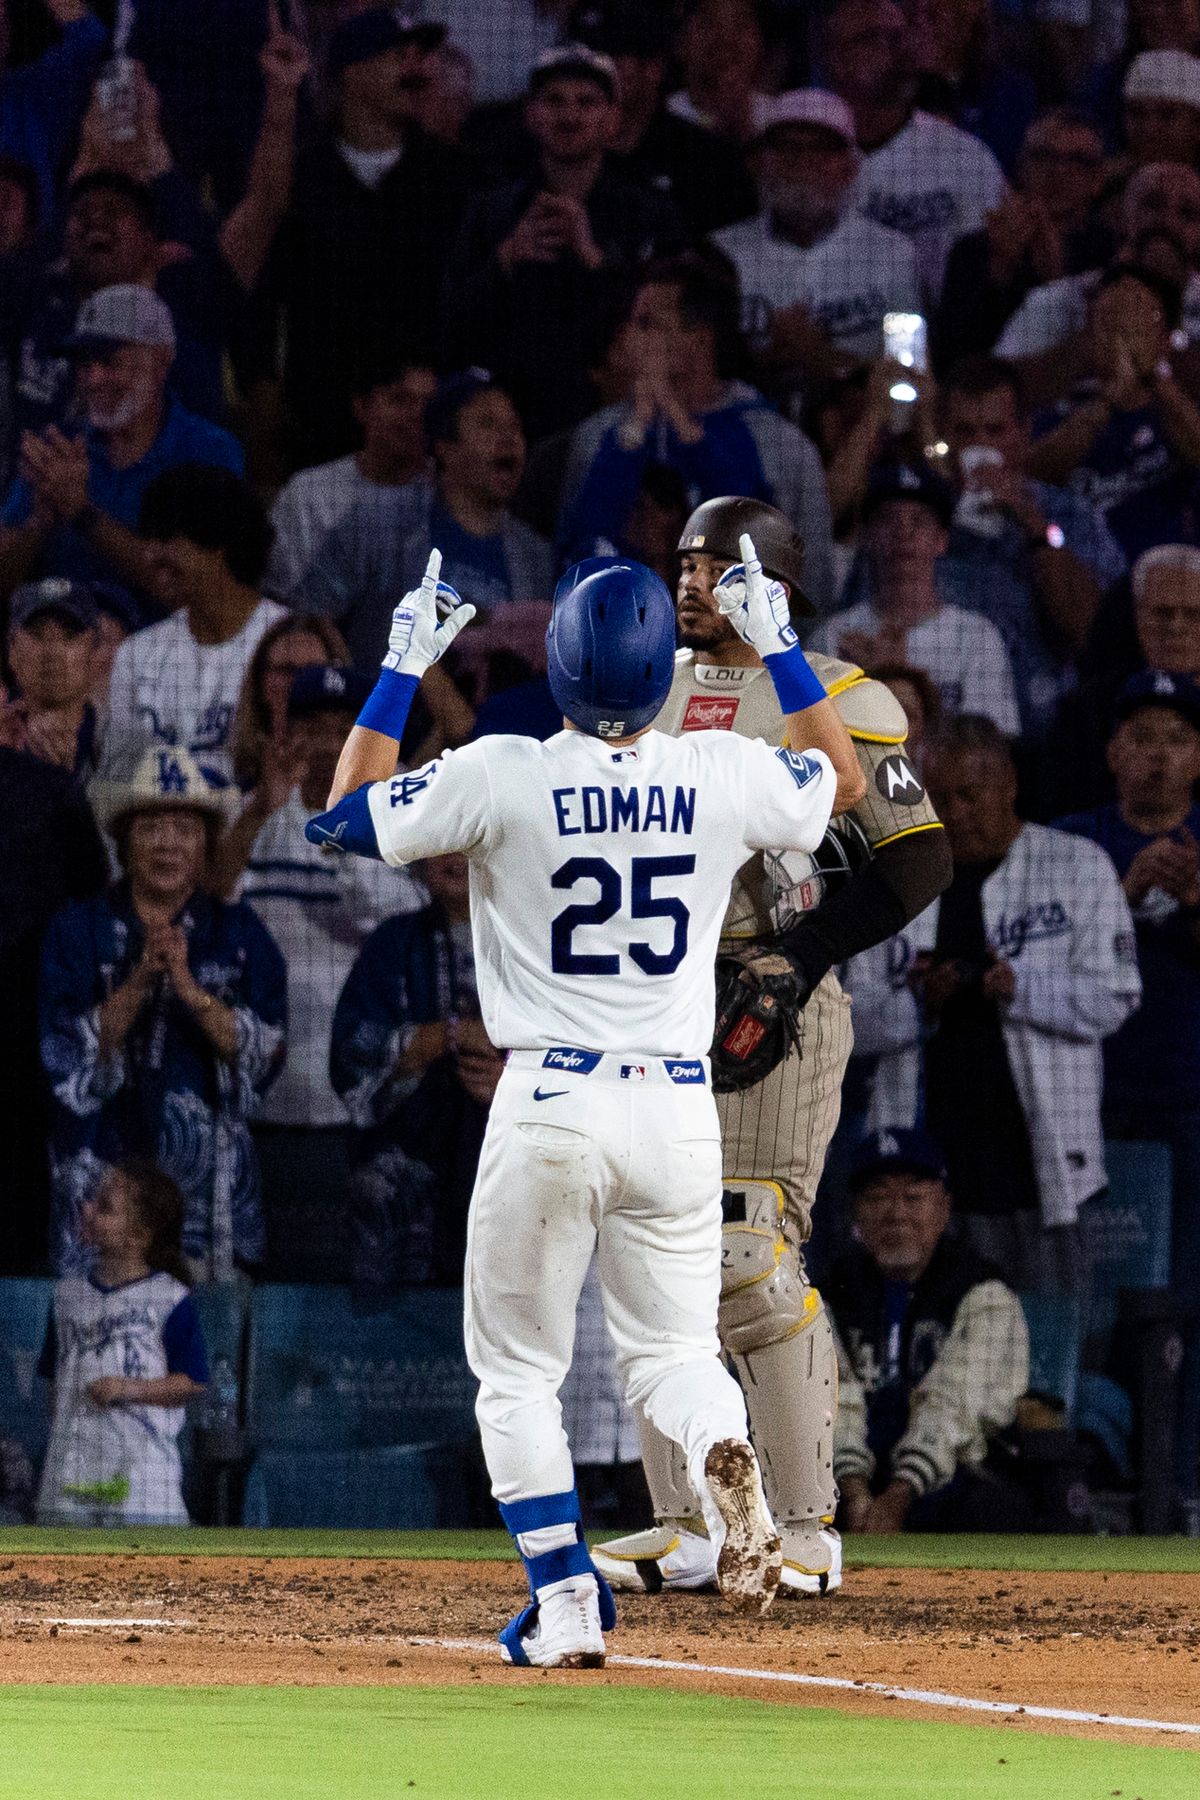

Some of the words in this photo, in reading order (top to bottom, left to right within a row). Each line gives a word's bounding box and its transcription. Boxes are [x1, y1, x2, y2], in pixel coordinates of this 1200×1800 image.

[703, 668, 744, 681] LOU
[597, 720, 625, 737] 25
[390, 762, 437, 808] LA
[552, 785, 697, 837] EDMAN
[551, 853, 697, 976] 25
